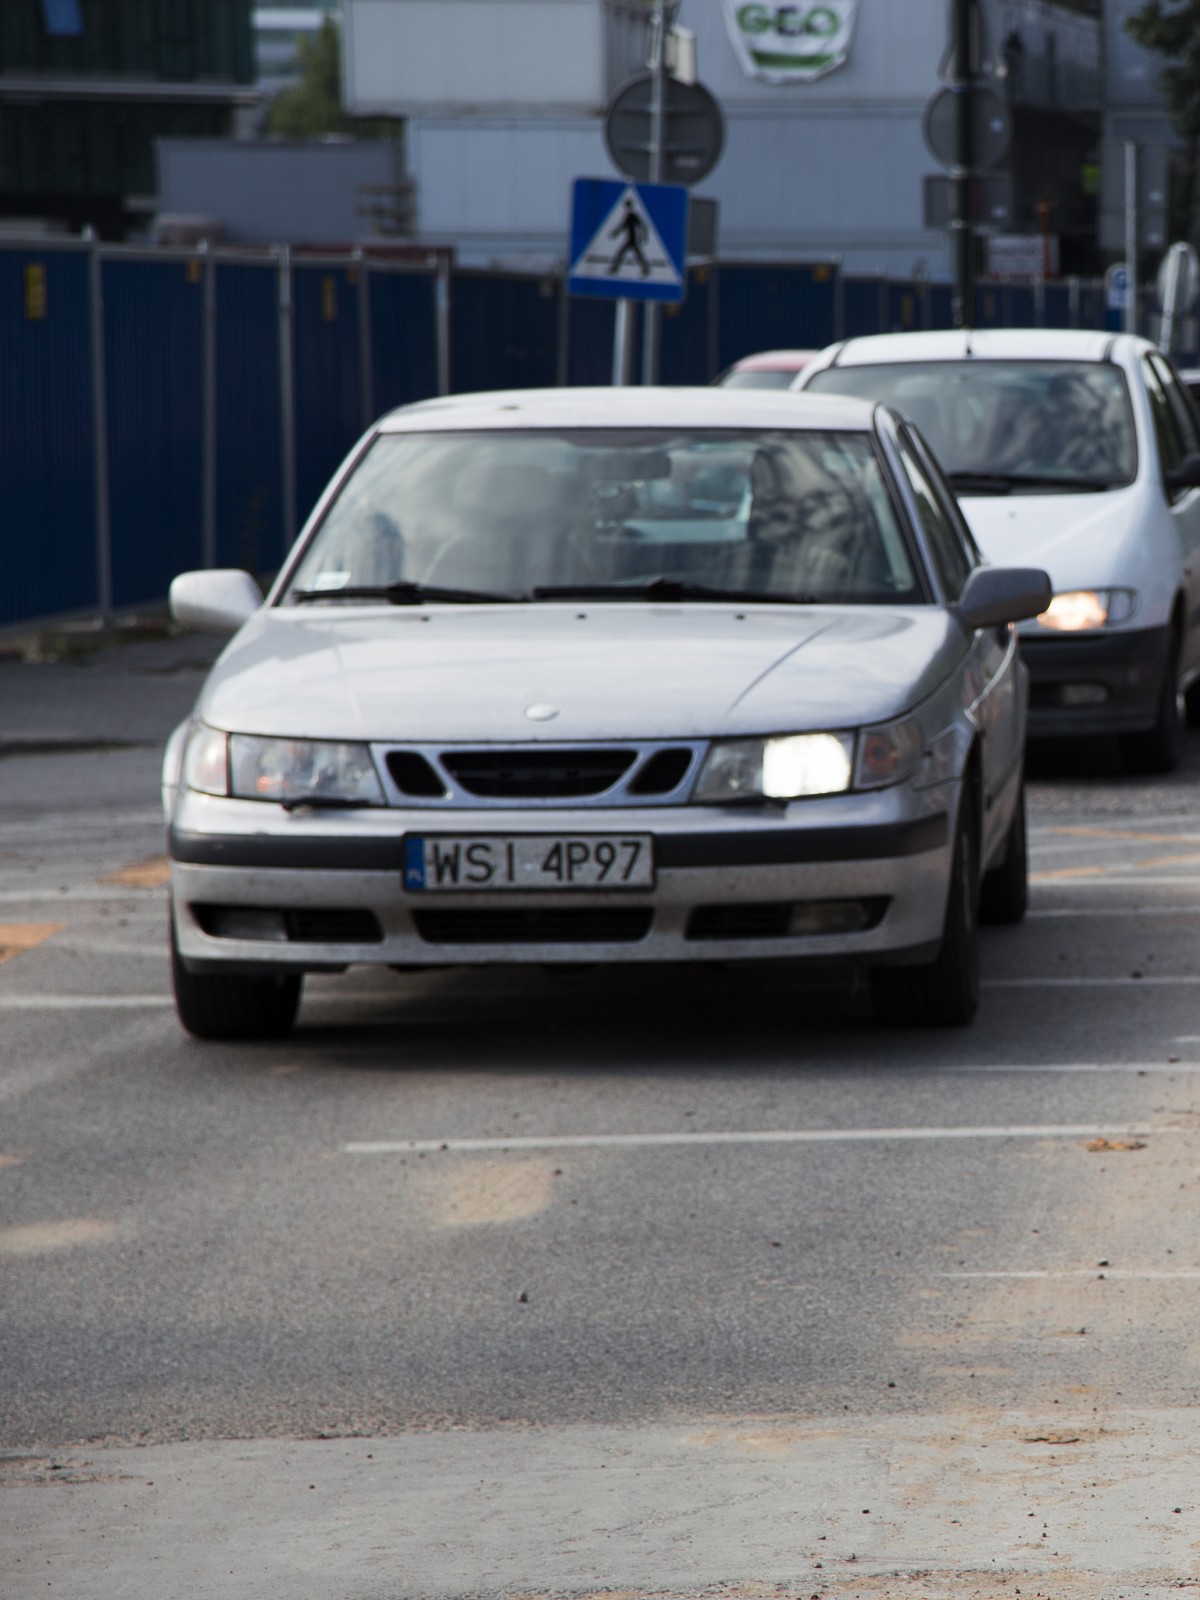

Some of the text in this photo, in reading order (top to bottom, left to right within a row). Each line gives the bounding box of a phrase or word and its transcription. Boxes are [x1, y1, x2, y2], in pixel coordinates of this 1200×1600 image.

[737, 3, 840, 37] GEO
[431, 841, 642, 883] WSI 4P97
